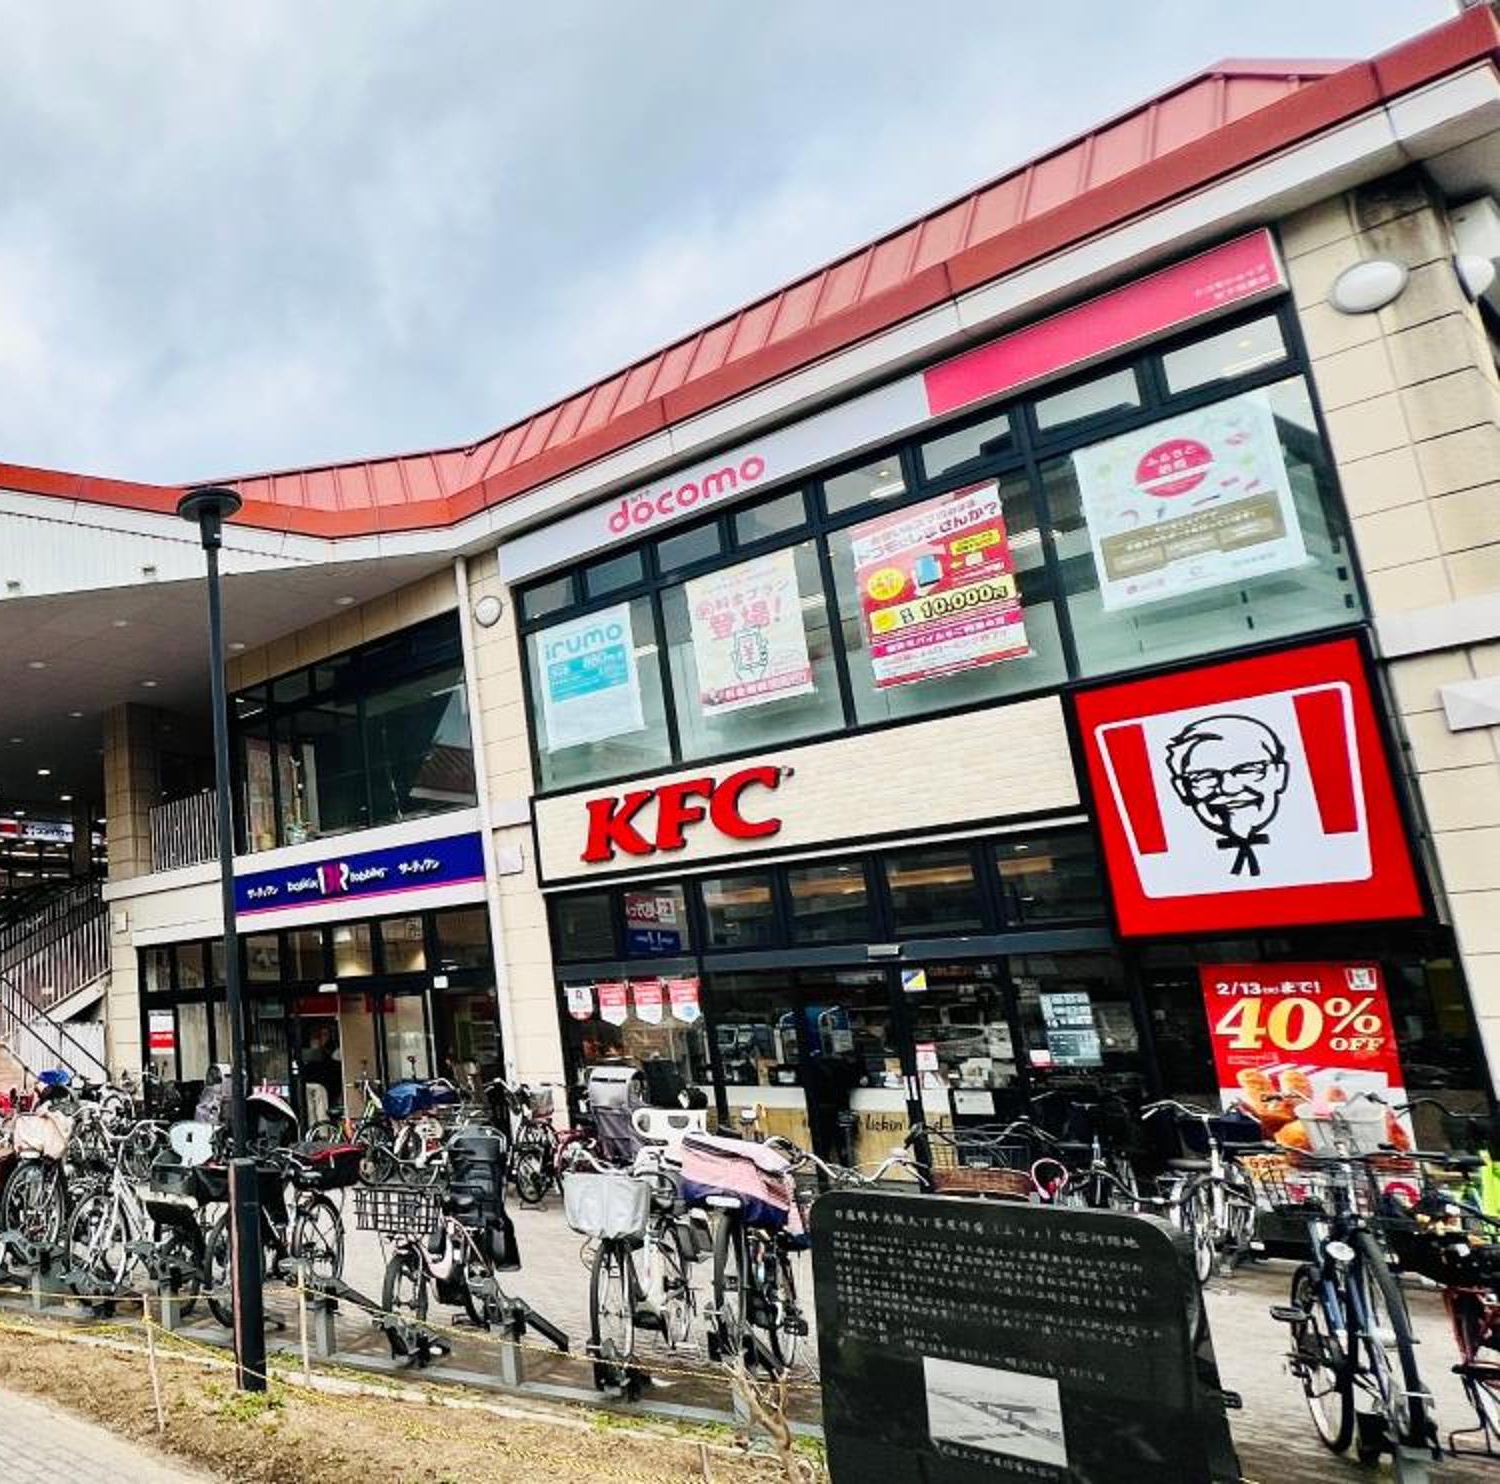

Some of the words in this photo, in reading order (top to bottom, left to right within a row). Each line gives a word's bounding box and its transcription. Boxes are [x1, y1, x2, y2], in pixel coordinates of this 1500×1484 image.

[608, 455, 766, 534] docomo
[545, 623, 623, 660] irumo
[581, 765, 783, 864] KFC
[1214, 996, 1383, 1051] 40%
[1329, 1037, 1386, 1051] OFF
